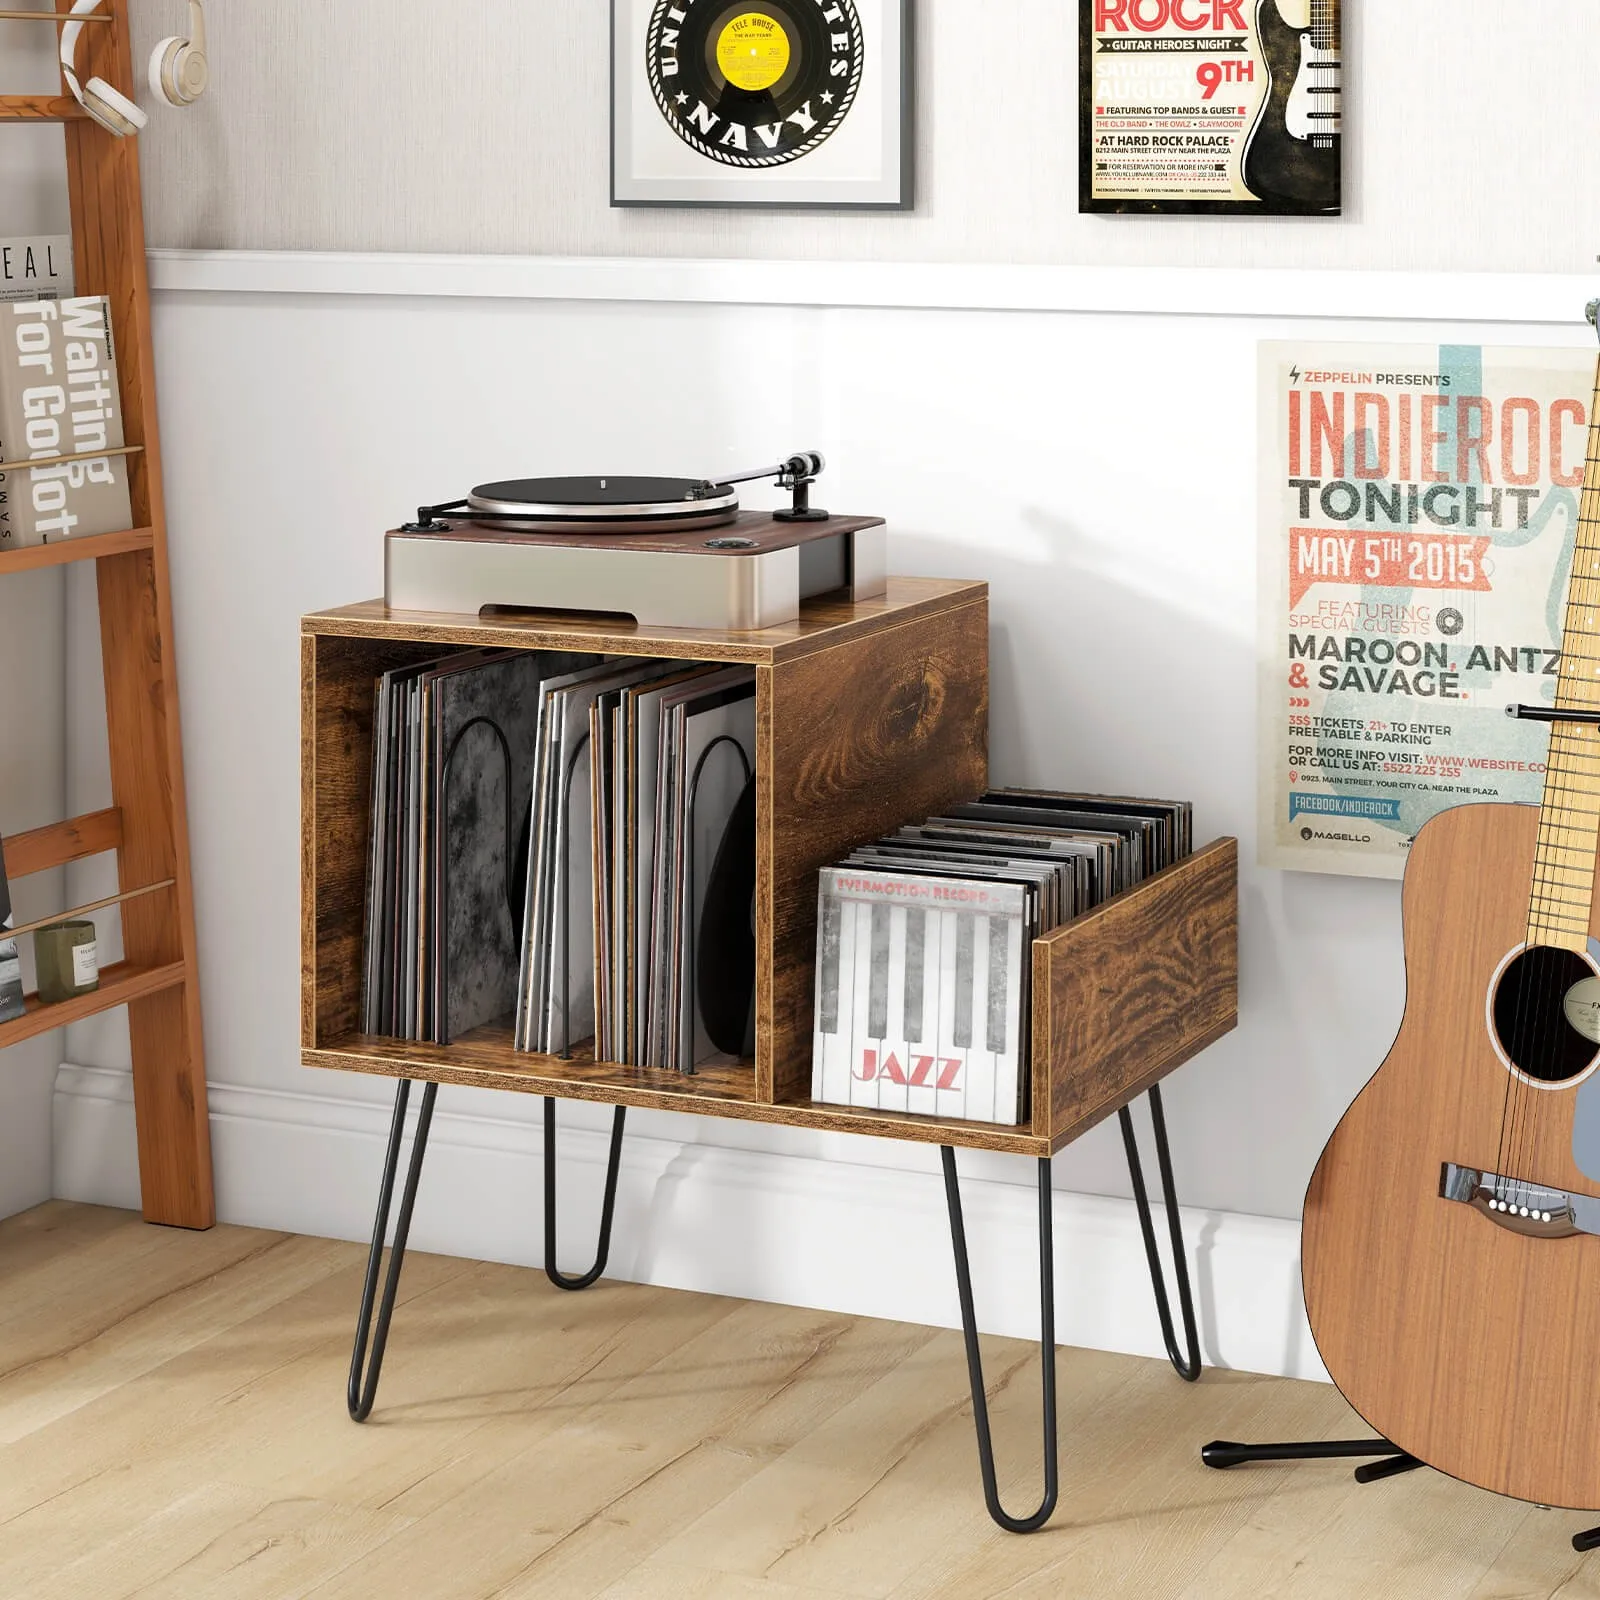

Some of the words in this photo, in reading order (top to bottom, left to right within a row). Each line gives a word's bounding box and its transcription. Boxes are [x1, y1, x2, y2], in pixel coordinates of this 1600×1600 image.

[732, 19, 748, 32] TELE
[752, 18, 775, 32] HOUSE
[1095, 0, 1248, 32] ROCK
[1112, 40, 1152, 51] GUITAR
[1153, 40, 1195, 50] HEROES
[1196, 39, 1231, 50] NIGHT
[1095, 61, 1191, 78] SATURDAY
[1196, 60, 1254, 100] 9TH
[1095, 80, 1192, 100] AUGUST
[1106, 107, 1151, 115] FEATURING
[686, 101, 819, 150] NAVY
[1099, 136, 1115, 146] AT
[1117, 136, 1150, 146] HARD
[1152, 136, 1183, 146] ROCK
[1186, 136, 1229, 146] PALACE
[14, 300, 58, 375] for
[1304, 371, 1372, 384] ZEPPELIN
[1376, 373, 1451, 386] PRESENTS
[61, 296, 114, 488] Waiting
[1288, 390, 1585, 488] INDIEROC
[1288, 479, 1540, 530] TONIGHT
[1298, 536, 1355, 577] MAY
[1365, 539, 1401, 578] 5TH
[1408, 541, 1476, 583] 2015
[1318, 600, 1430, 622] FEATURING
[1289, 614, 1359, 632] SPECIAL
[1363, 618, 1430, 636] GUESTS
[1289, 634, 1457, 672] MAROON,
[1465, 644, 1561, 675] ANTZ
[1288, 662, 1310, 689] &
[1318, 664, 1469, 699] SAVAGE.
[1289, 715, 1311, 726] 35$
[1313, 717, 1367, 731] TICKETS,
[1369, 720, 1388, 731] 21+
[1390, 722, 1407, 732] TO
[1410, 724, 1451, 736] ENTER
[1289, 726, 1320, 738] FREE
[1322, 728, 1361, 741] TABLE
[1364, 731, 1372, 742] &
[1375, 732, 1431, 745] PARKING
[1289, 745, 1313, 756] FOR
[1316, 747, 1352, 759] MORE
[1356, 749, 1385, 761] INFO
[1388, 752, 1423, 764] VISIT:
[1289, 756, 1306, 767] OR
[1309, 757, 1340, 769] CALL
[1342, 759, 1359, 770] US
[1362, 761, 1381, 772] AT:
[1383, 763, 1412, 774] 5522
[1415, 765, 1436, 776] 225
[1439, 767, 1461, 778] 255
[1322, 776, 1343, 784] MAIN
[1376, 780, 1398, 788] YOUR
[1399, 782, 1417, 790] CITY
[1432, 784, 1454, 793] NEAR
[1455, 786, 1471, 794] THE
[1472, 787, 1499, 796] PLAZA
[1295, 796, 1394, 816] FACEBOOK/INDIEROCK
[1314, 831, 1371, 842] MAGELLO
[836, 877, 929, 898] EVERMOTION
[851, 1049, 963, 1092] JAZZ
